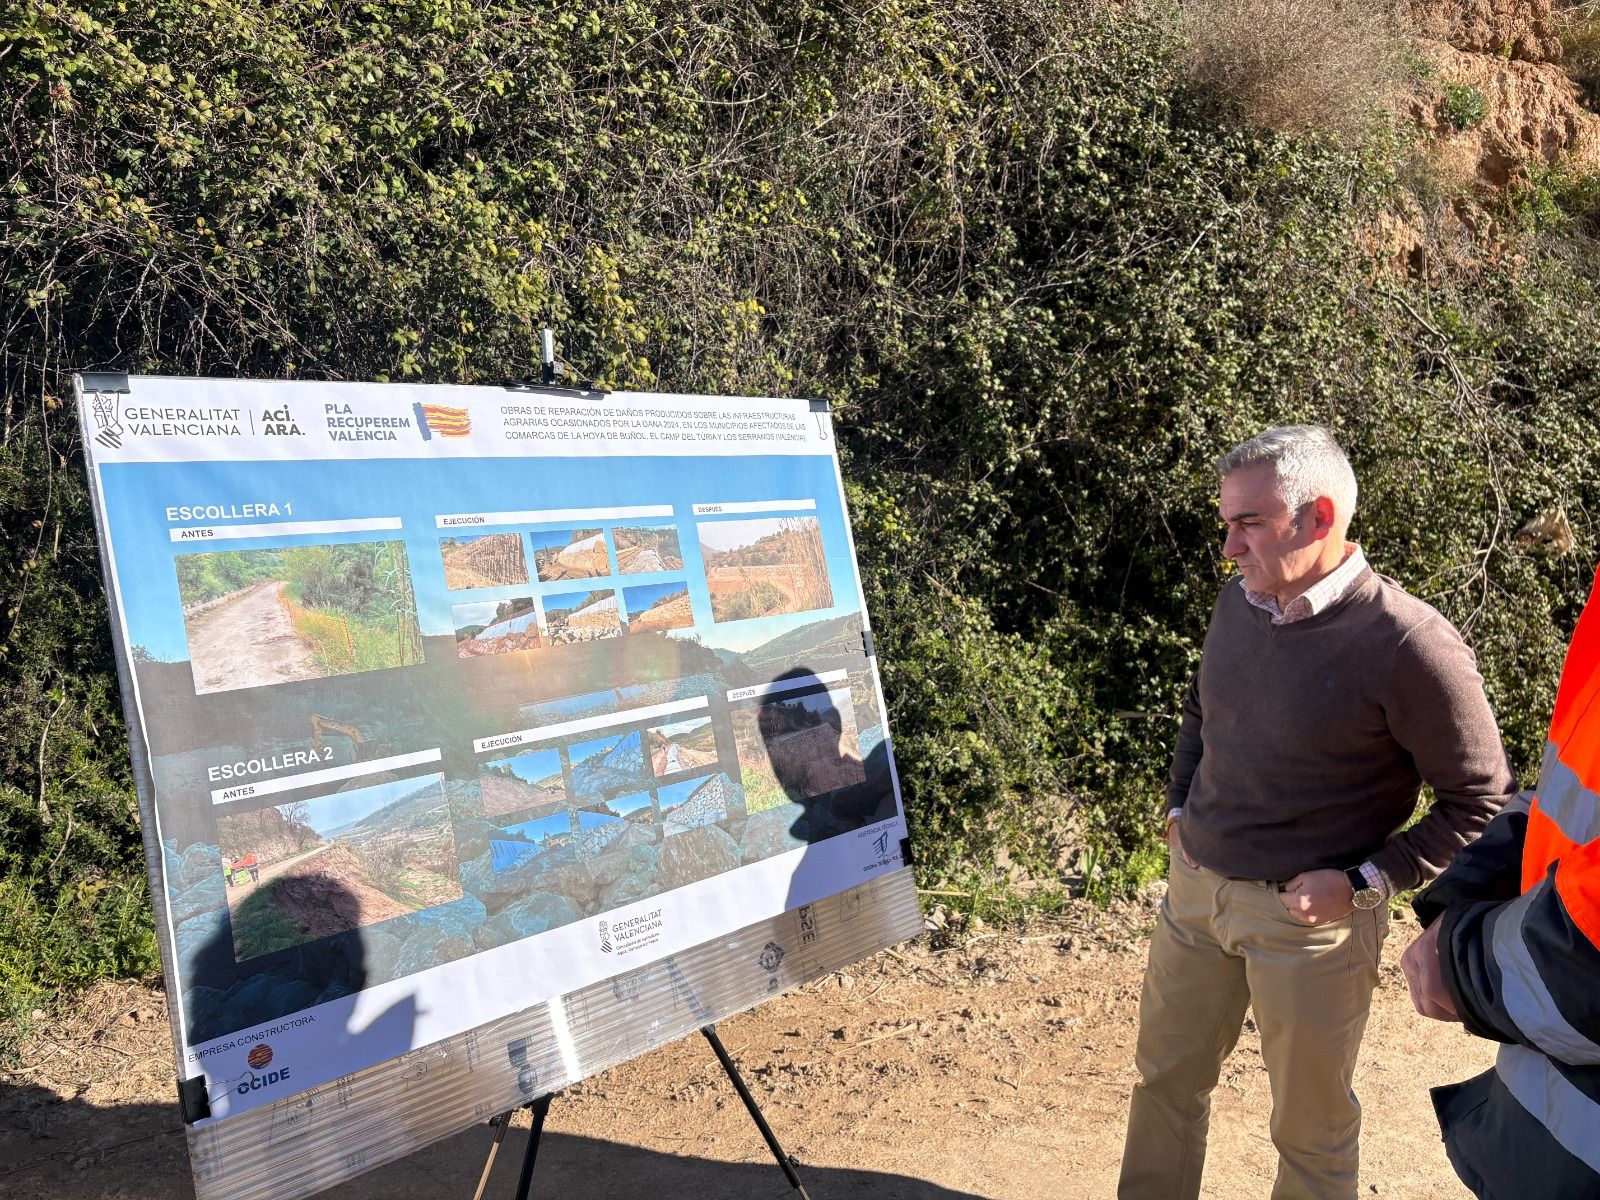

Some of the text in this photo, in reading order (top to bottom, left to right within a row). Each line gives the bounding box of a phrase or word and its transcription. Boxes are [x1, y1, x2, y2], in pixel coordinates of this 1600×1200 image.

[124, 407, 241, 422] GENERALITAT
[324, 403, 353, 415] PLA
[500, 406, 796, 421] OBRAS DE REPARACIÓN DE DAÑOS PRODUCIDOS SOBRE LAS INFRAESTRUCTURAS
[326, 416, 411, 428] RECUPEREM
[503, 418, 549, 427] AGRARIAS
[550, 418, 612, 428] OCASIONADOS
[612, 420, 630, 428] POR
[631, 420, 642, 428] LA
[642, 420, 663, 428] DANA
[682, 421, 693, 429] EN
[693, 421, 708, 429] LOS
[709, 421, 748, 430] MUNICIPIOS
[749, 421, 787, 430] AFECTADOS
[128, 422, 242, 437] VALENCIANA
[264, 423, 306, 436] ARA.
[328, 428, 398, 441] VALÈNCIA
[505, 431, 556, 440] COMARCAS
[557, 431, 569, 440] DE
[571, 431, 582, 440] LA
[583, 431, 606, 440] HOYA
[607, 431, 619, 440] DE
[649, 432, 660, 440] EL
[660, 432, 680, 441] CAMP
[681, 432, 696, 441] DEL
[723, 433, 737, 441] LOS
[737, 433, 775, 441] SERRANOS
[166, 502, 292, 521] ESCOLLERA 1
[443, 516, 485, 525] EJECUCIÓN
[181, 529, 214, 538] ANTES
[481, 735, 523, 749] EJECUCIÓN
[207, 746, 334, 782] ESCOLLERA 2
[222, 786, 255, 800] ANTES
[612, 908, 662, 933] GENERALITAT
[613, 919, 663, 941] VALENCIANA
[188, 1014, 317, 1063] EMPRESA CONSTRUCTORA:
[237, 1067, 291, 1095] OCIDE
